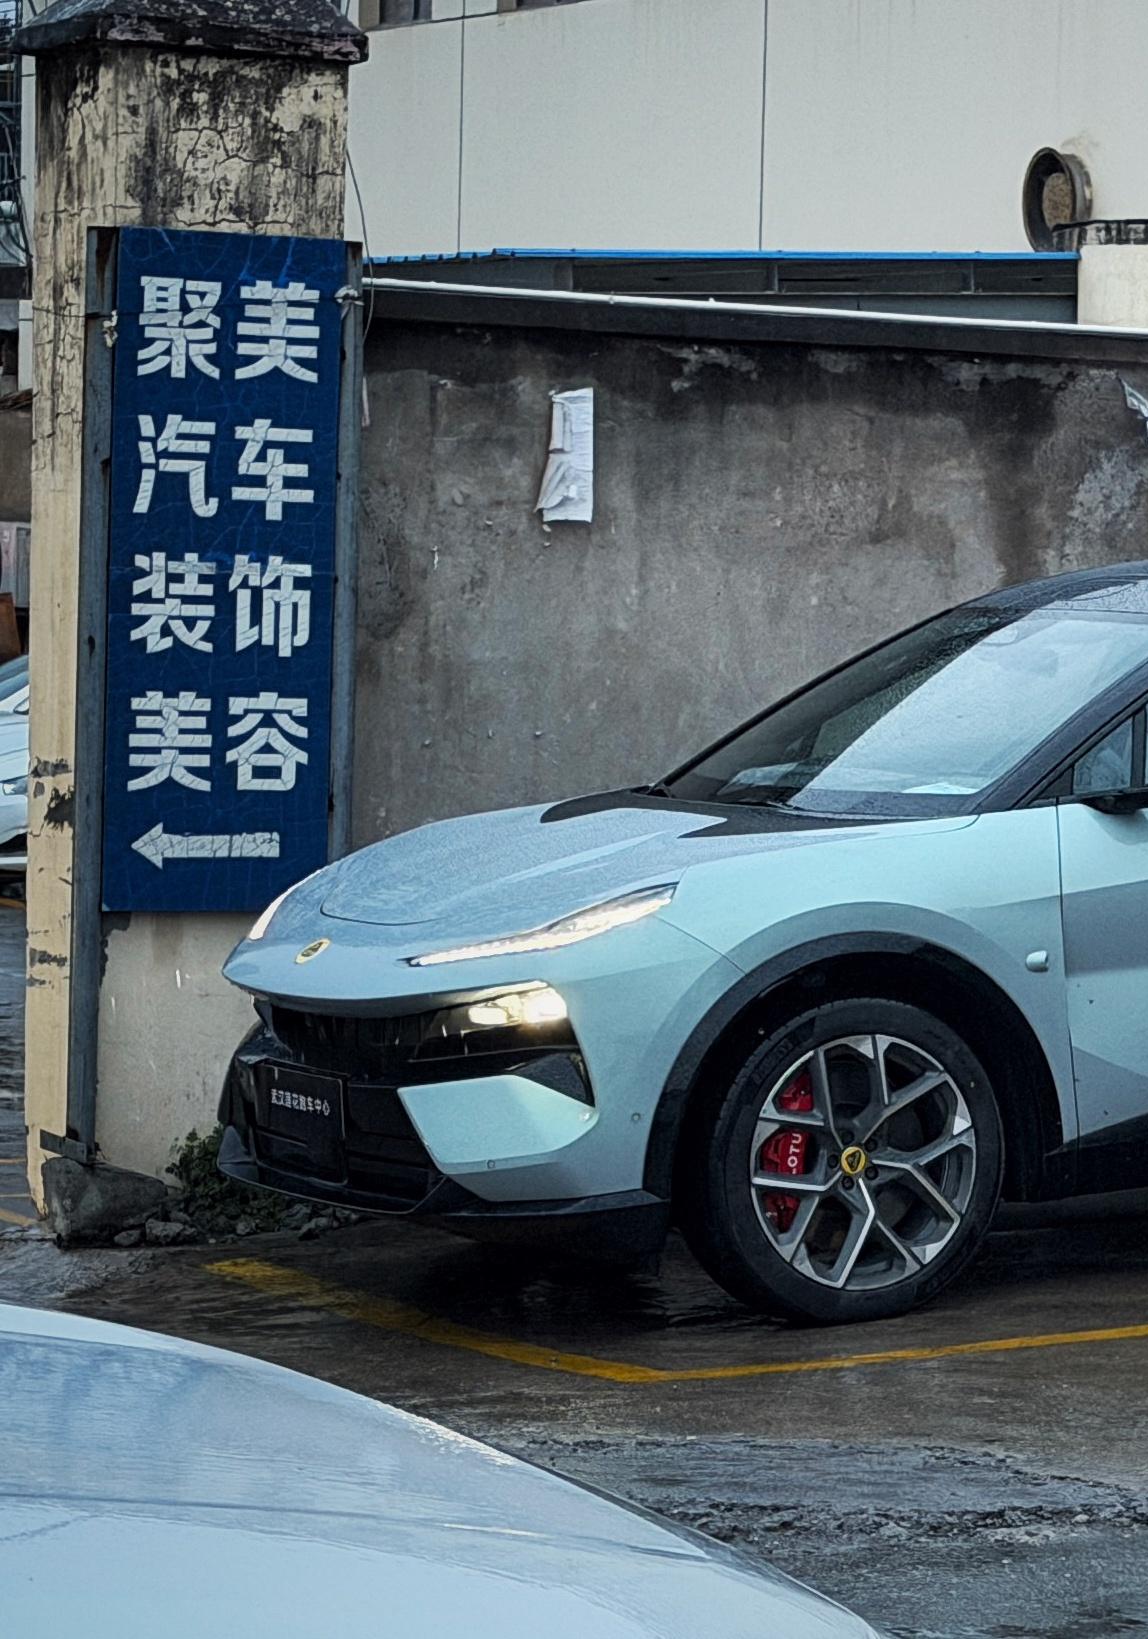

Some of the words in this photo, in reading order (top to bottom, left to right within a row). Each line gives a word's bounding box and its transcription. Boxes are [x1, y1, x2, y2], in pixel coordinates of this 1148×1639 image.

[137, 275, 320, 383] 聚美
[133, 414, 315, 521] 汽车
[130, 552, 313, 657] 装饰
[127, 690, 309, 792] 美容
